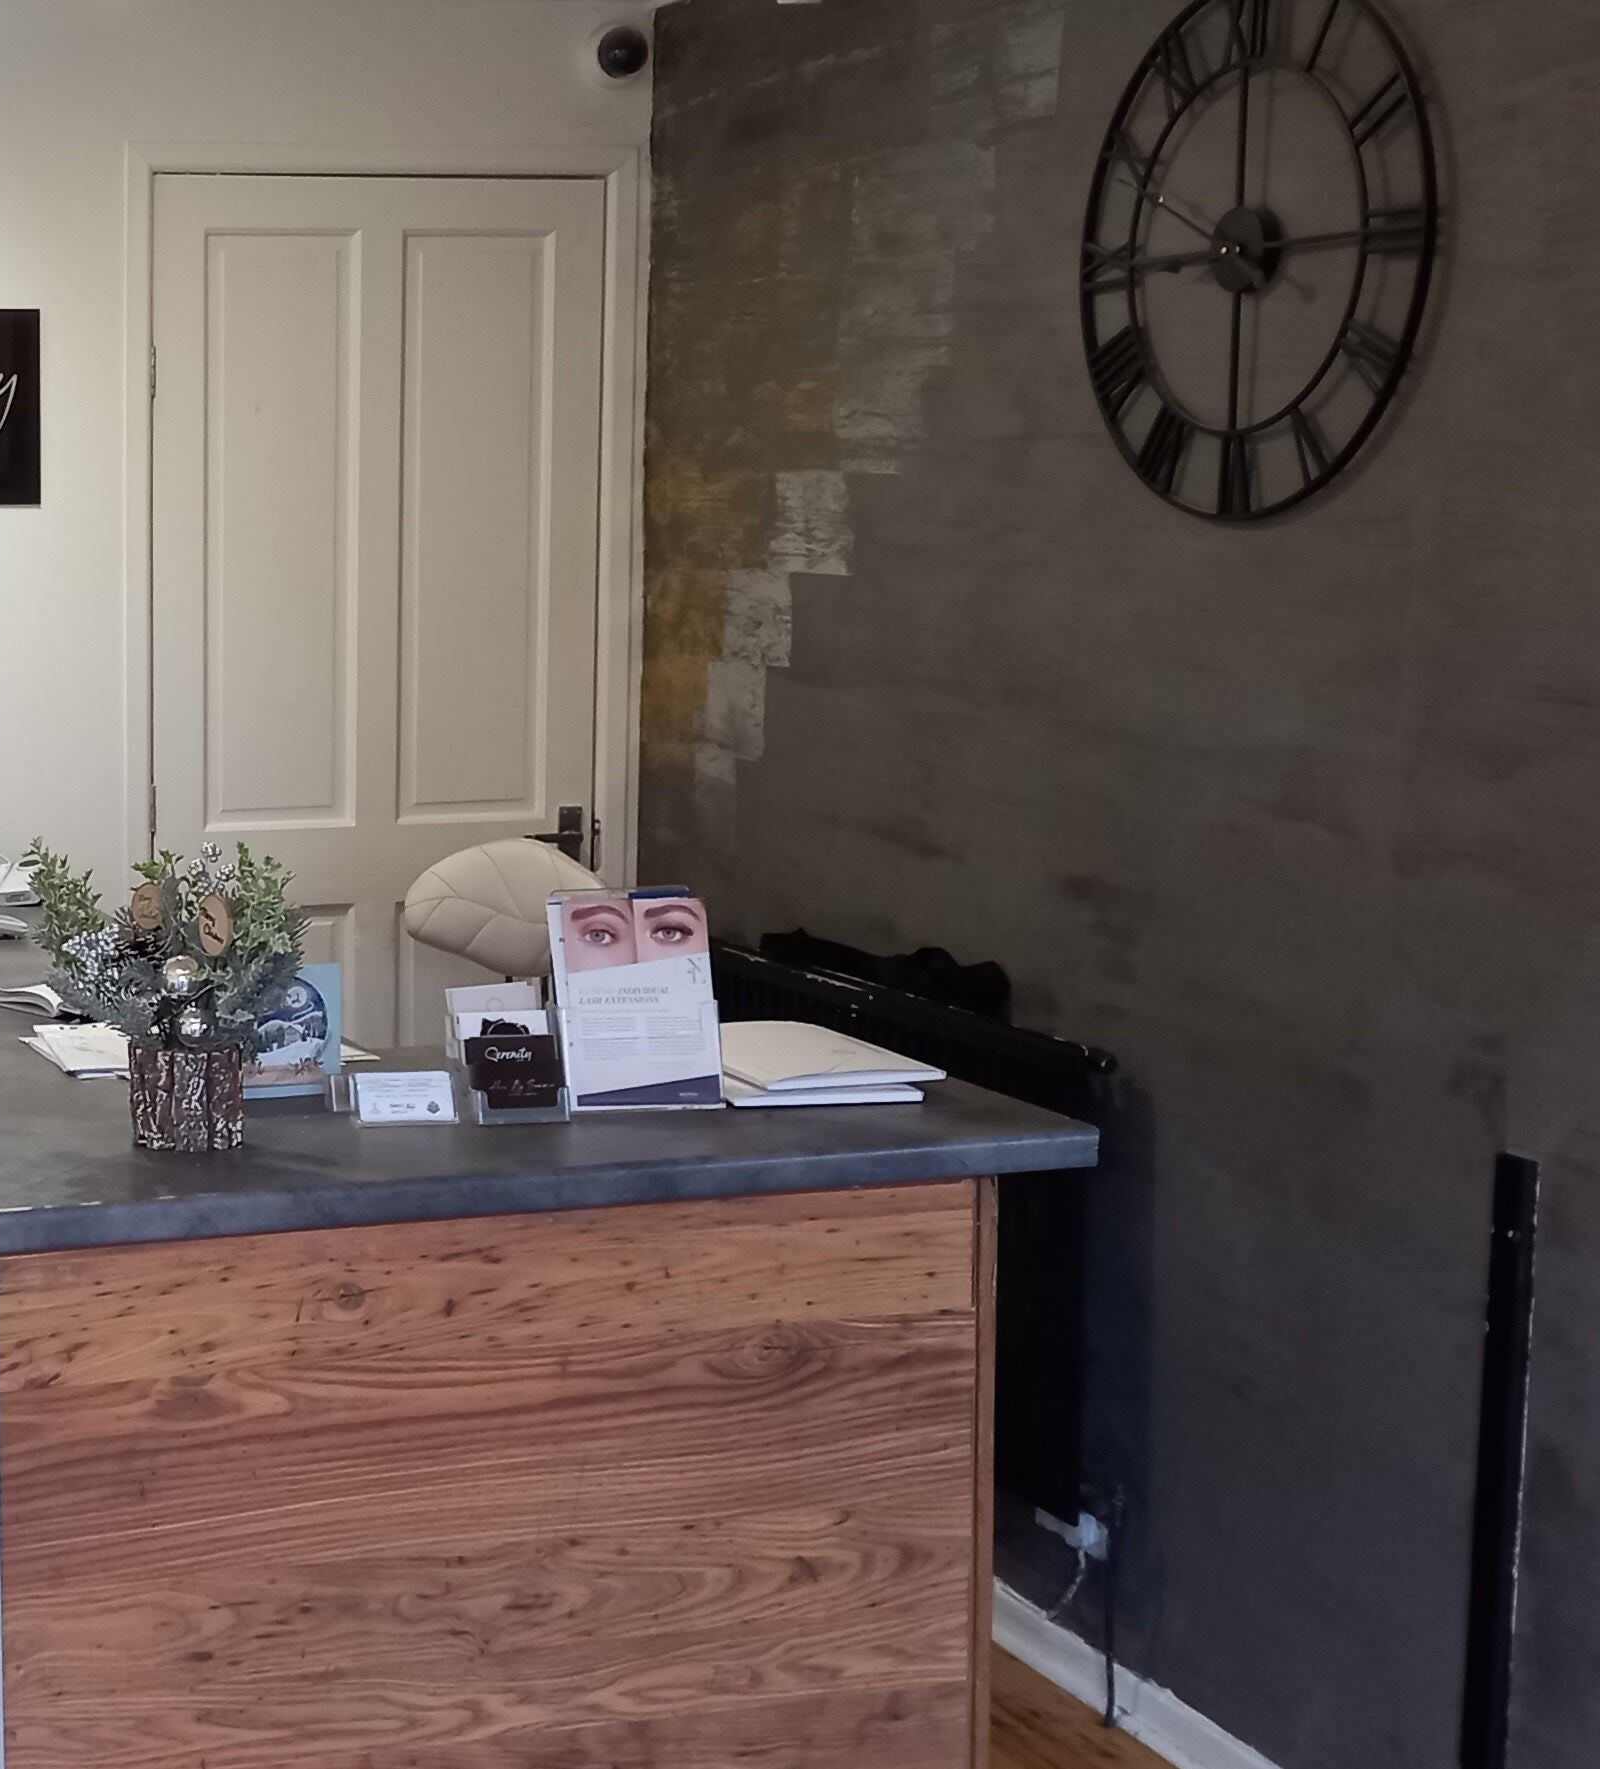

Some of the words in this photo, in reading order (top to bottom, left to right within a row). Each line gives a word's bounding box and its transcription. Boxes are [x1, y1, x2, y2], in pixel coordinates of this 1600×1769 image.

[578, 996, 602, 1005] LASH
[603, 996, 660, 1005] EXTENSIONS
[484, 1046, 532, 1063] Serenity
